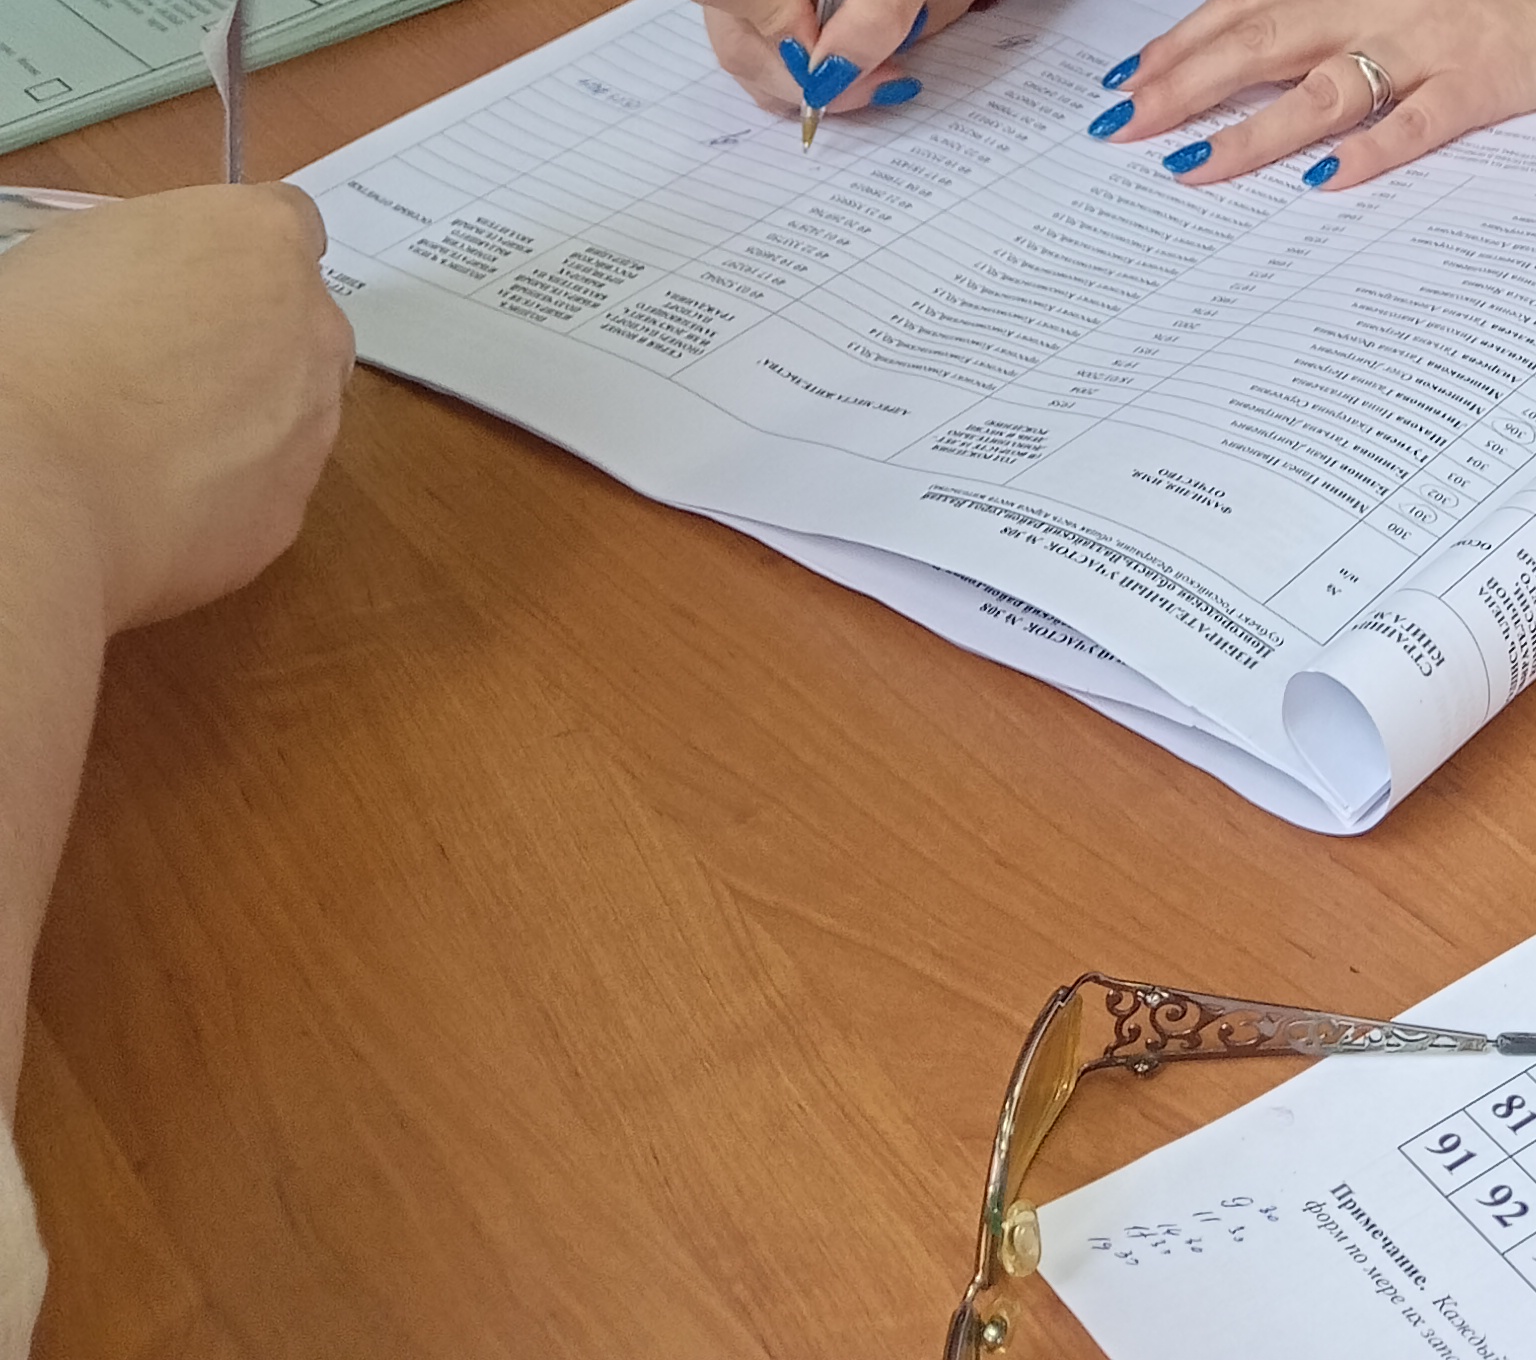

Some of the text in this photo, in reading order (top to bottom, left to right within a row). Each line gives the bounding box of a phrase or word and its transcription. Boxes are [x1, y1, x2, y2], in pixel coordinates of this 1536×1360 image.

[1504, 423, 1528, 438] 306
[1485, 439, 1509, 456] 305
[1466, 455, 1490, 472] 304
[1446, 472, 1472, 488] 303
[1427, 487, 1452, 505] 302
[1408, 505, 1433, 524] 301
[998, 525, 1026, 538] 308
[1387, 522, 1412, 541] 300
[1042, 537, 1120, 580] УЧАСТОК
[978, 601, 1005, 617] 308
[1118, 574, 1258, 670] ИЗБИРАТЕЛЬНЫЙ
[1176, 588, 1273, 660] Новгородская
[1022, 619, 1097, 656] УЧАСТОК
[1426, 1133, 1477, 1174] 91
[1476, 1185, 1529, 1228] 92
[1329, 1180, 1428, 1291] Примечание.
[1302, 1199, 1348, 1243] форм
[1345, 1243, 1368, 1264] по
[1363, 1266, 1406, 1305] мере
[1402, 1306, 1426, 1328] их
